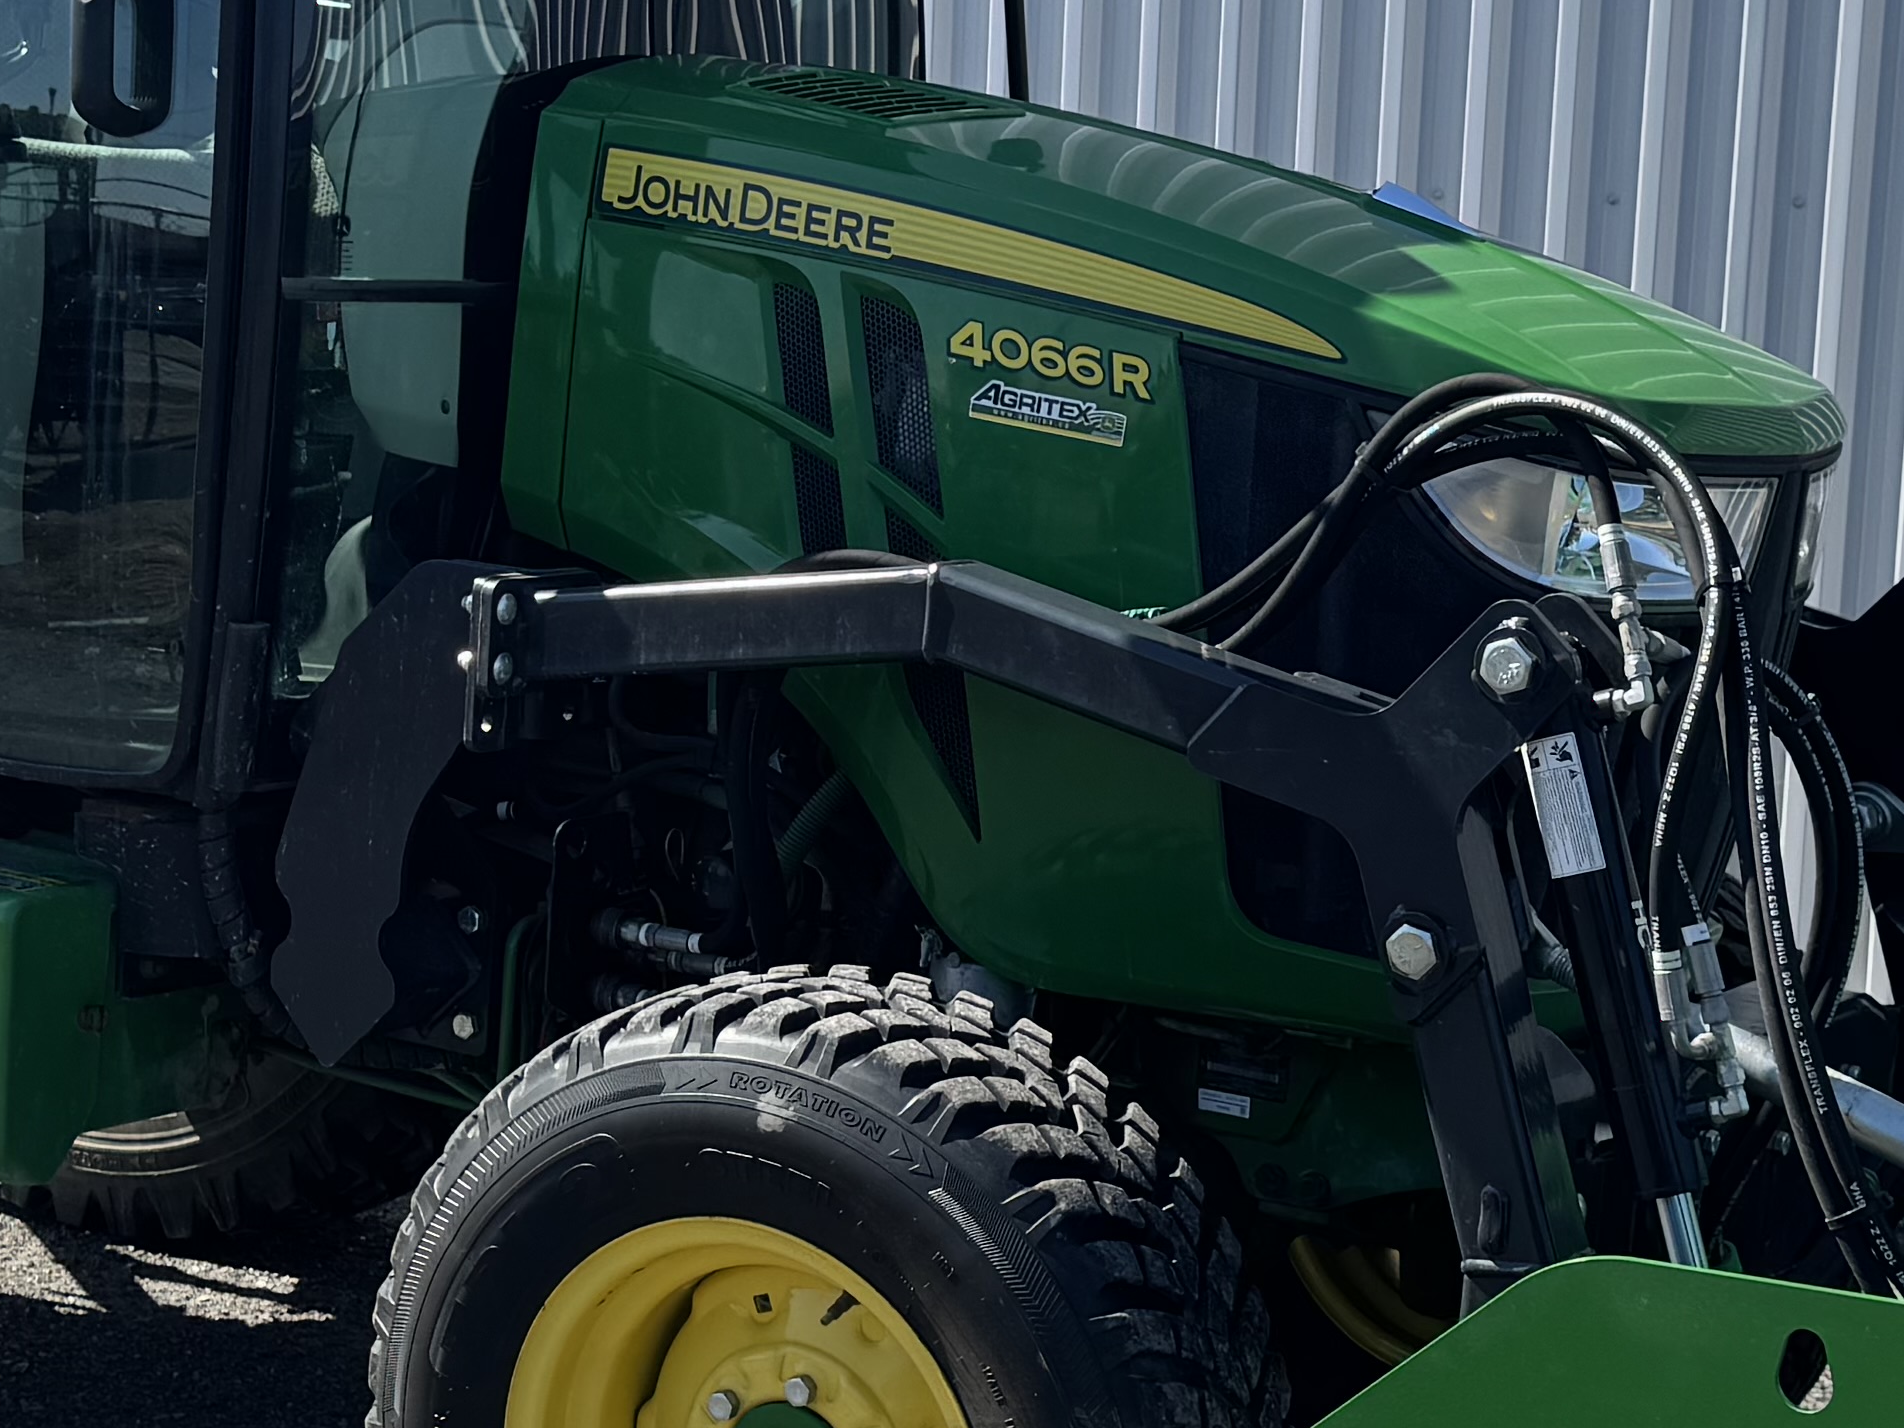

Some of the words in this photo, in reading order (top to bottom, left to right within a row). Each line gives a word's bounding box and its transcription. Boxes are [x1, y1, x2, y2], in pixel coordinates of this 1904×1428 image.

[617, 164, 731, 222] JOHN
[738, 182, 894, 253] DEERE
[949, 320, 1152, 400] 4066R
[973, 383, 1094, 423] AGRITEX
[1672, 467, 1693, 492] DN10
[1691, 498, 1707, 521] SAE
[1736, 612, 1748, 637] BAR
[1693, 665, 1707, 695] BAR
[1743, 663, 1755, 688] W.P.
[1675, 733, 1688, 754] PSI
[1755, 794, 1768, 821] SAE
[1759, 831, 1772, 863] DN10
[1763, 866, 1776, 892] 2SN
[1771, 920, 1788, 965] DIN/EN
[1785, 988, 1797, 1004] 02
[1798, 1039, 1829, 1114] TRANSFLEX
[729, 1071, 887, 1143] ROTATION
